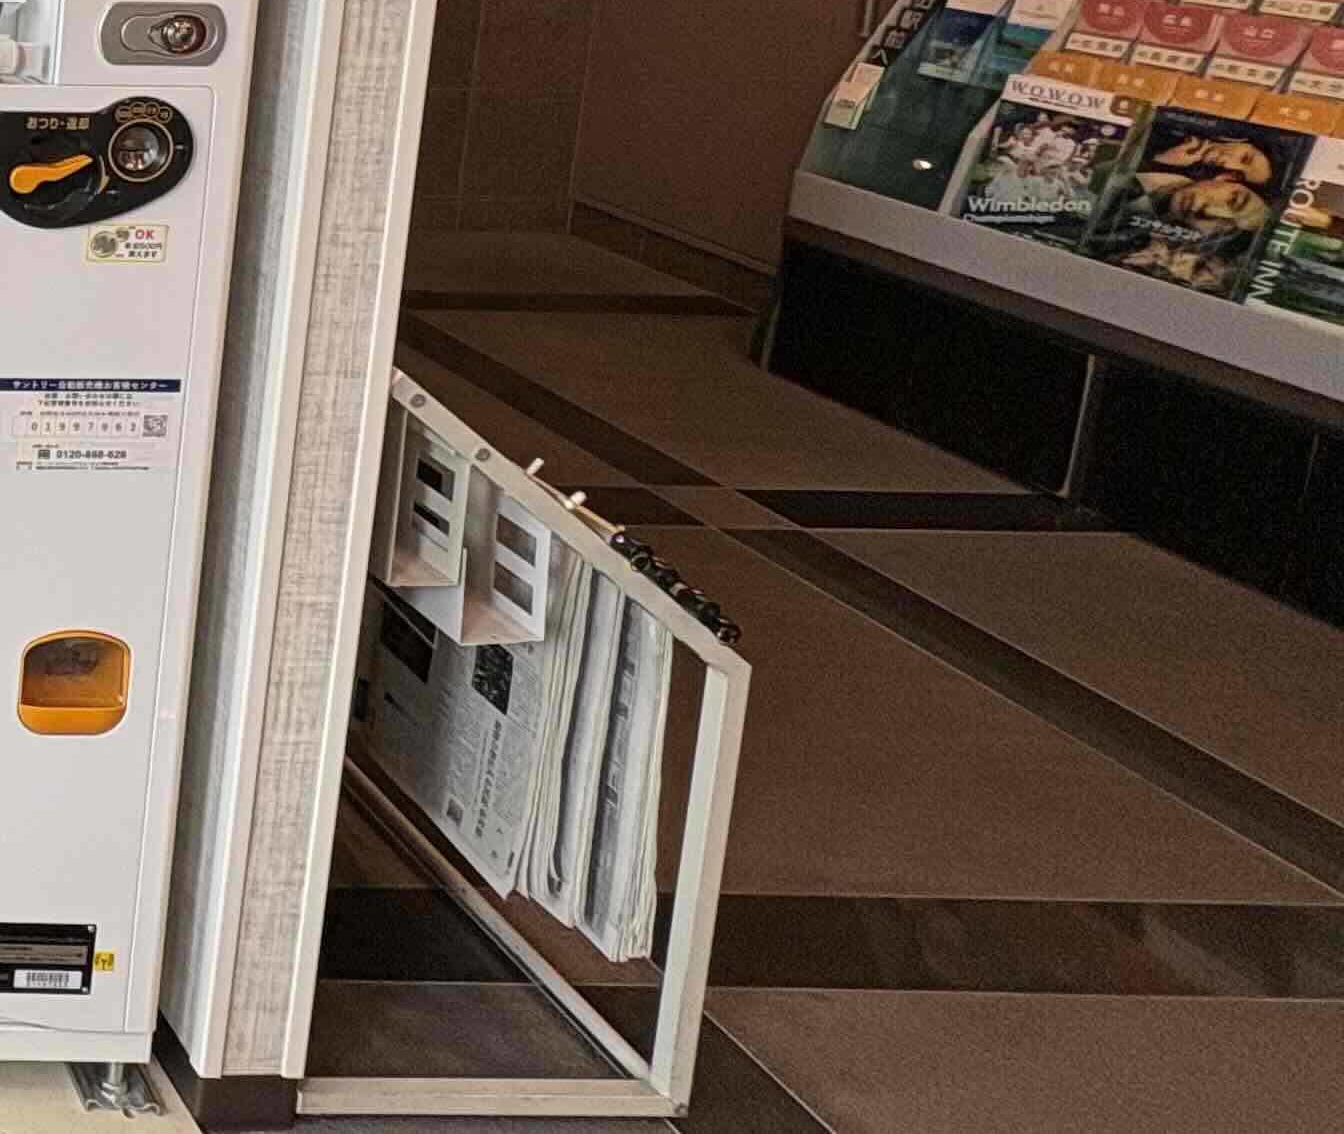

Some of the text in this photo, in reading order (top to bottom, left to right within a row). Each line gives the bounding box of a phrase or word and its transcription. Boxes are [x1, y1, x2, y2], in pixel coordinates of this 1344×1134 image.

[967, 195, 1093, 214] Wimbledon
[1271, 178, 1321, 257] ROUTE
[134, 228, 155, 241] OK
